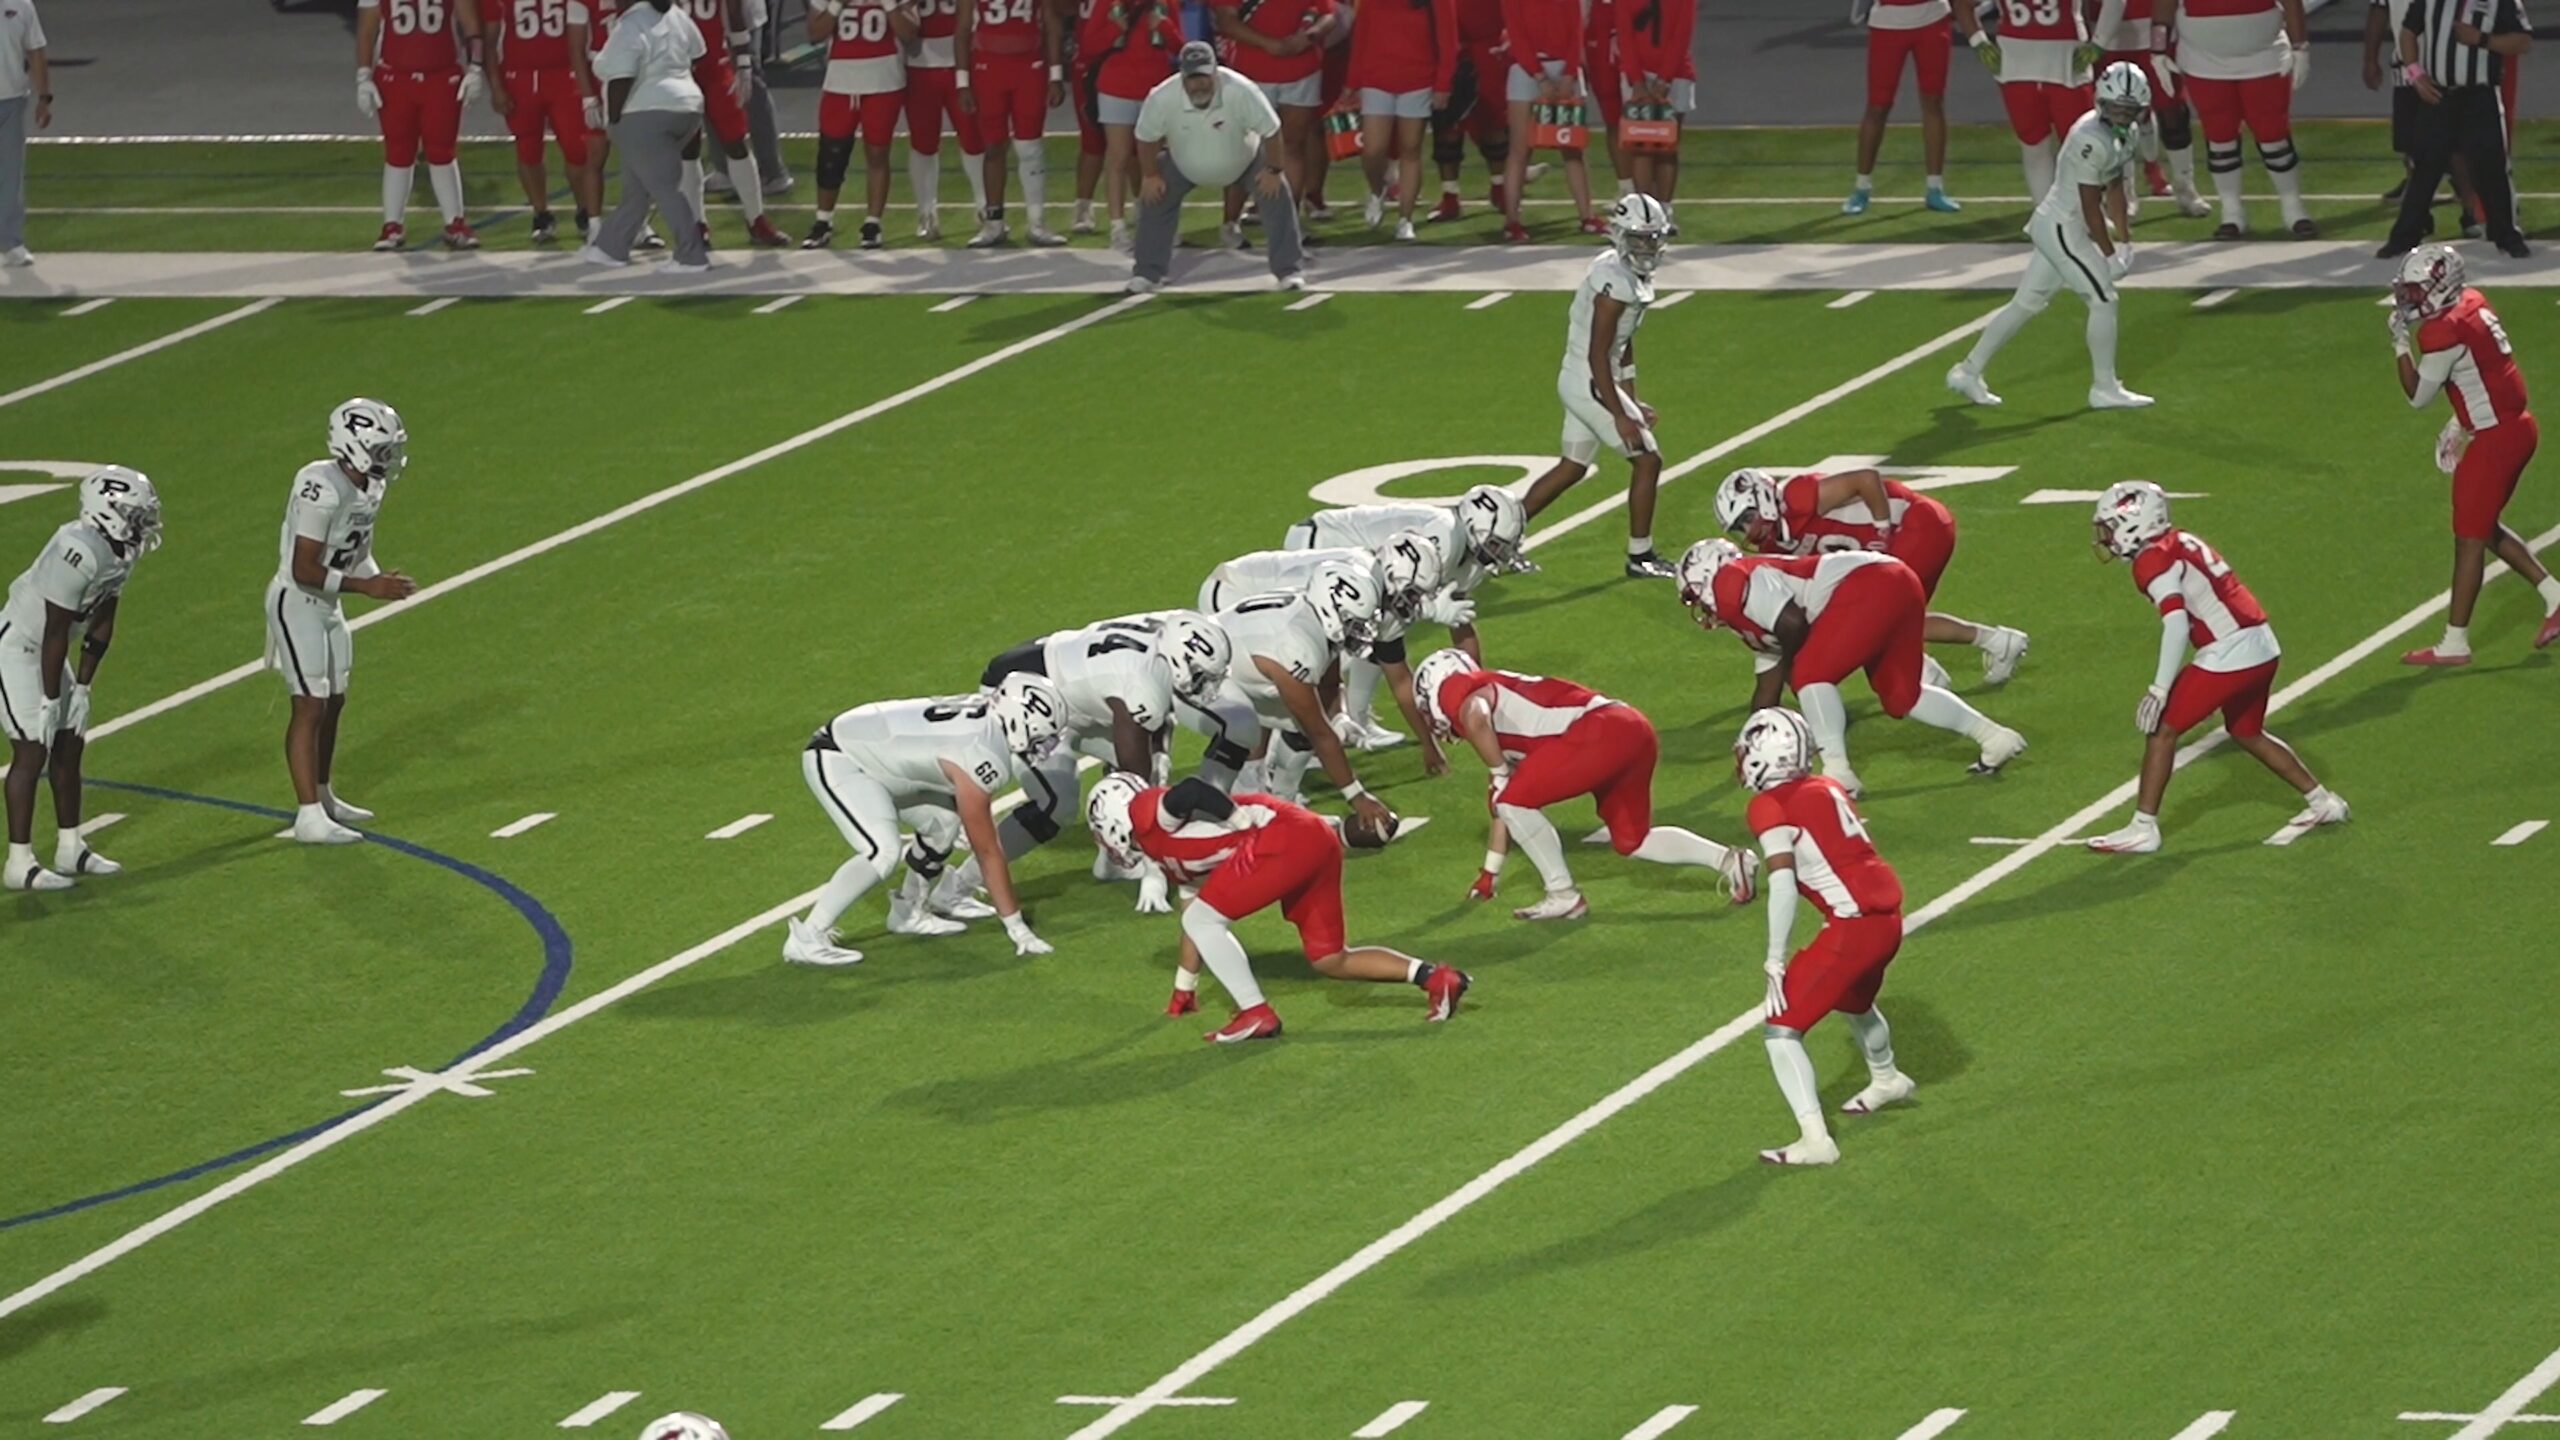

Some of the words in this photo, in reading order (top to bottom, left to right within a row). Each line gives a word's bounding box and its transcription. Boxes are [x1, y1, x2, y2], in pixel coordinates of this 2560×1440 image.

[390, 0, 444, 35] 56
[514, 0, 564, 39] 55
[838, 8, 887, 42] 60
[1556, 128, 1571, 144] G
[2081, 144, 2092, 159] 2
[345, 413, 374, 437] P
[301, 480, 322, 501] 25
[974, 760, 999, 785] 66
